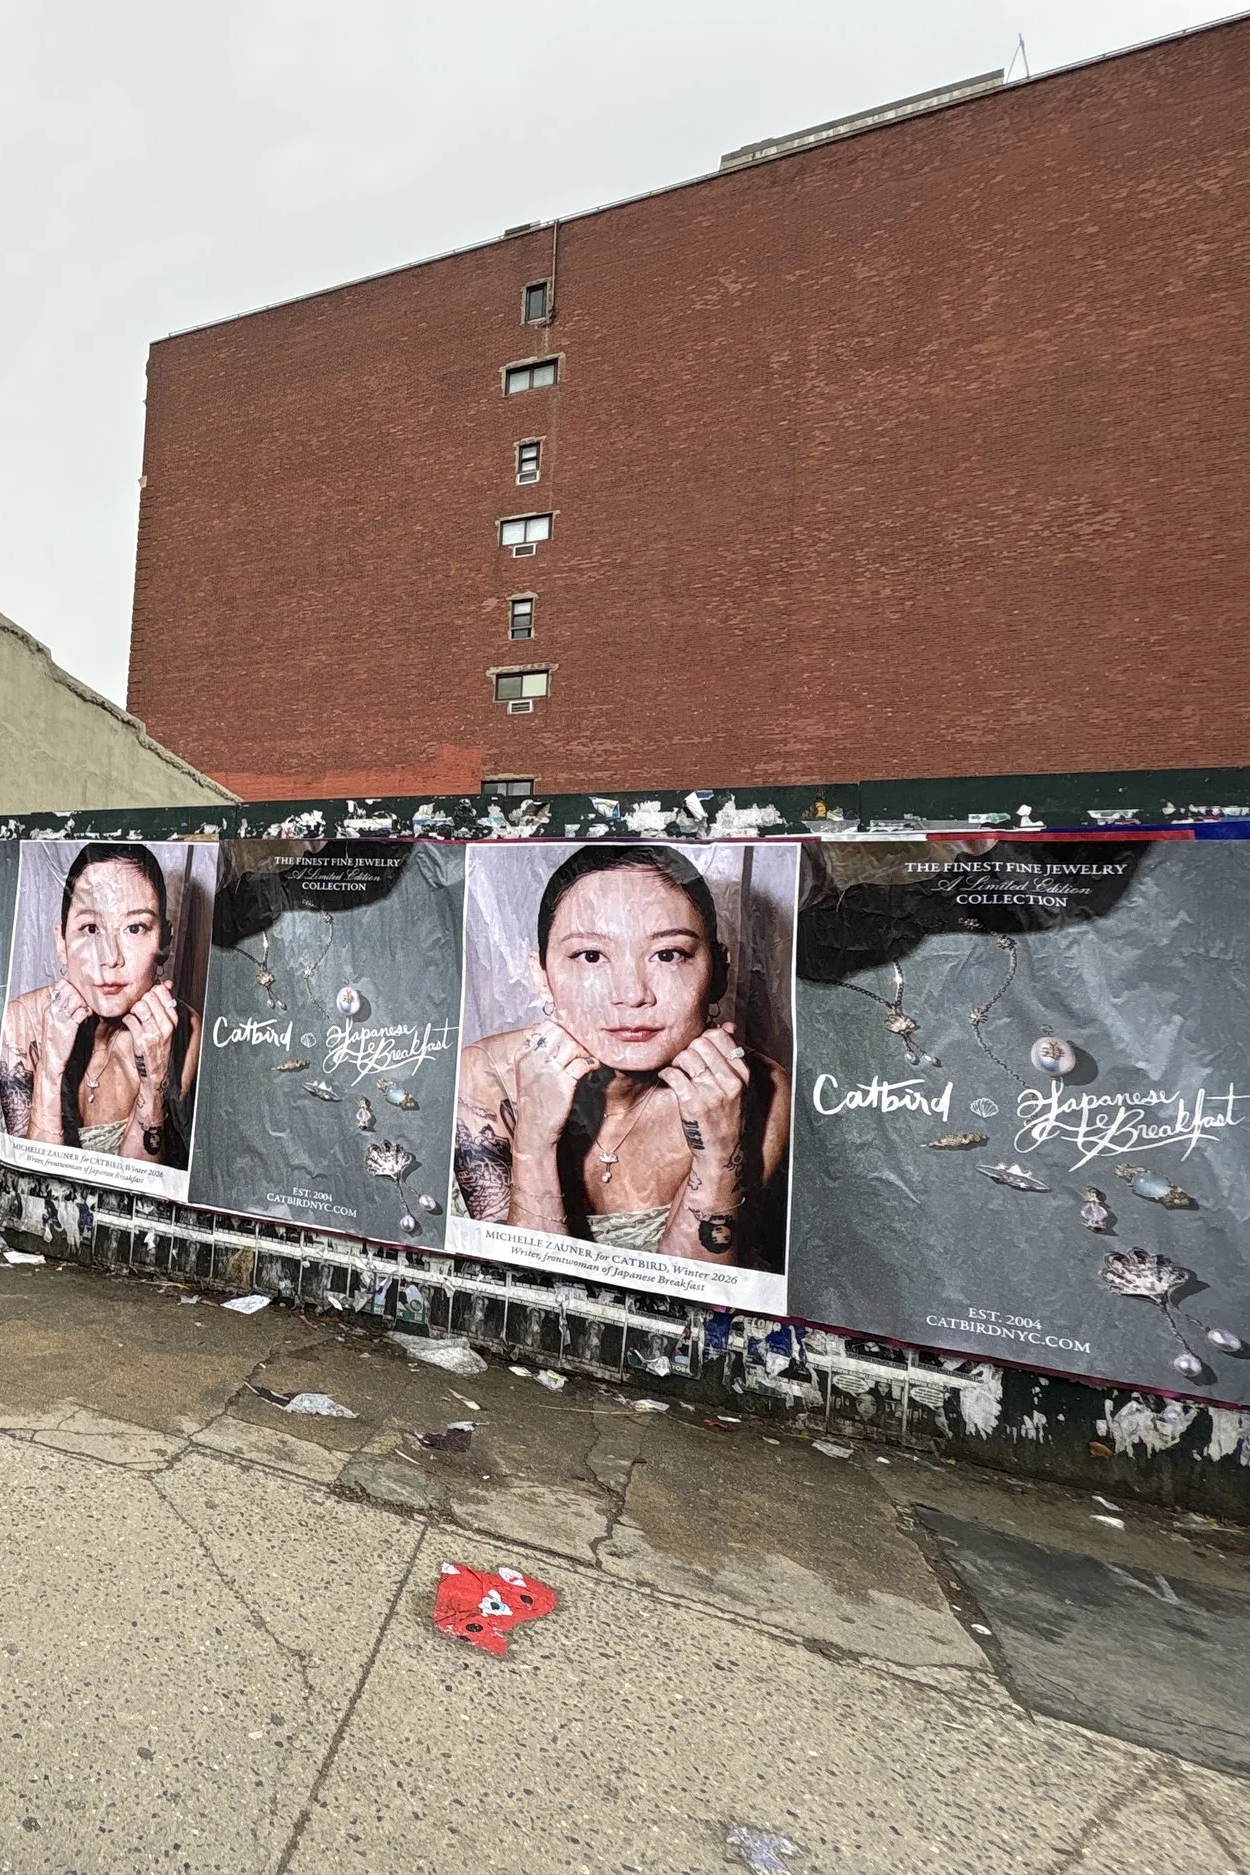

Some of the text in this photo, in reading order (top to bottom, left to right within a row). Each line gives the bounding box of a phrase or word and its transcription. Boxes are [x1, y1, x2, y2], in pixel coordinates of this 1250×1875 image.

[274, 856, 401, 868] THE FINEST FINE JEWELRY
[905, 861, 1129, 877] THE FINEST FINE JEWELRY
[288, 867, 381, 882] A Limited Edition
[302, 881, 367, 892] COLLECTION
[931, 875, 1093, 895] A Limited Edition
[956, 894, 1070, 908] COLLECTION
[212, 1015, 418, 1070] Catbird Japanese
[812, 1073, 1182, 1150] Catbird Japanese
[12, 1143, 164, 1178] MICHELLE ZAUNER for CATBIRD, Winter 2026
[266, 1192, 357, 1218] CATBIRDNYC.COM
[292, 1187, 333, 1202] EST. 2004
[485, 1229, 739, 1286] MICHELLE ZAUNER for CATBIRD, Winter 2026
[510, 1245, 707, 1293] Writer, frontwoman of Japanese Breakfast
[968, 1307, 1043, 1331] EST. 2004
[925, 1315, 1091, 1354] CATBIRDNYC.COM
